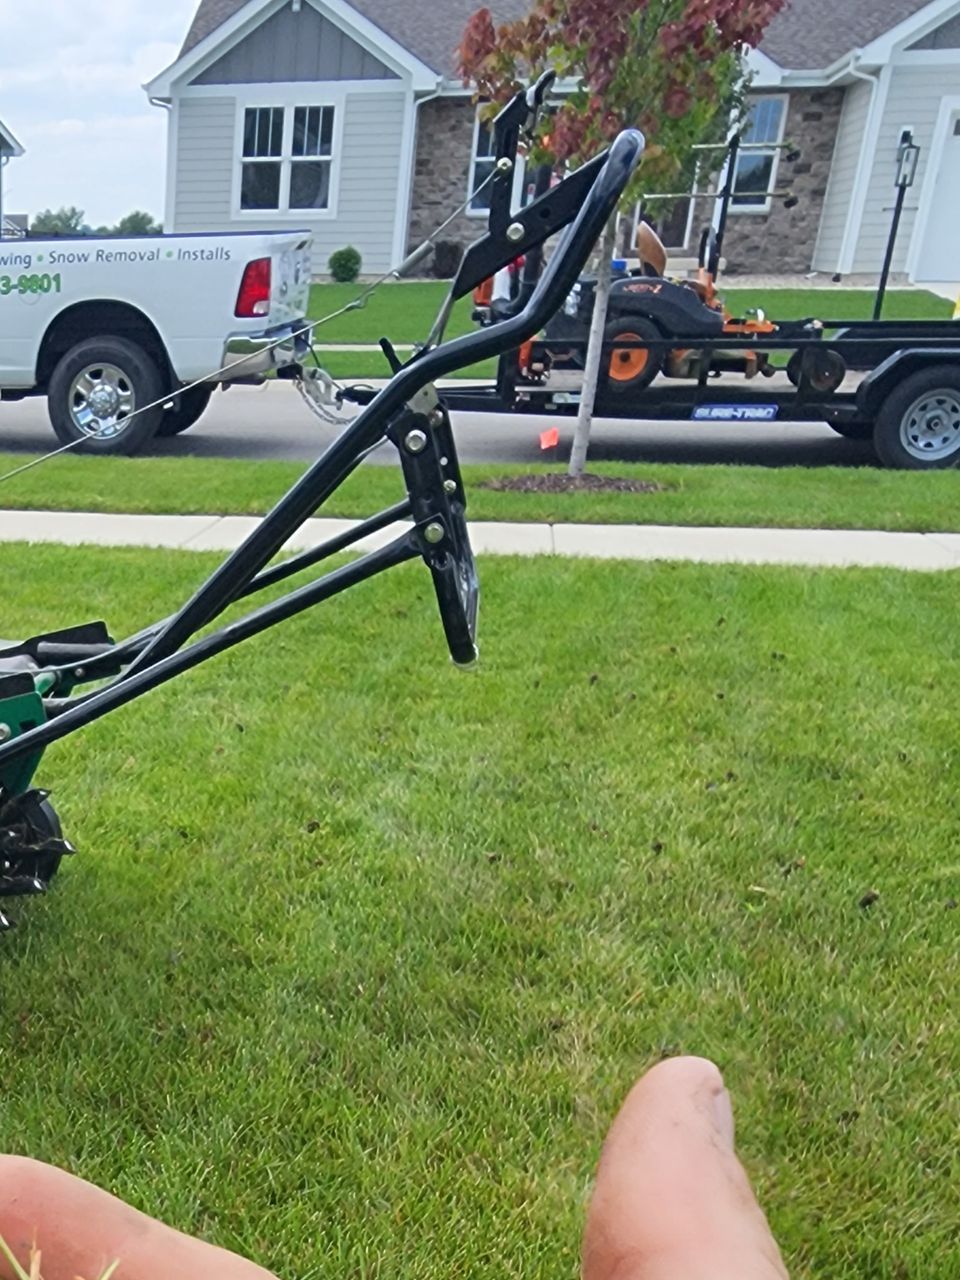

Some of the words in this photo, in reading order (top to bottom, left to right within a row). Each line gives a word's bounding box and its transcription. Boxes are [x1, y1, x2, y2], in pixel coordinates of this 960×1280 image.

[49, 250, 90, 264] Snow
[95, 247, 160, 262] Removal
[177, 246, 231, 261] Installs
